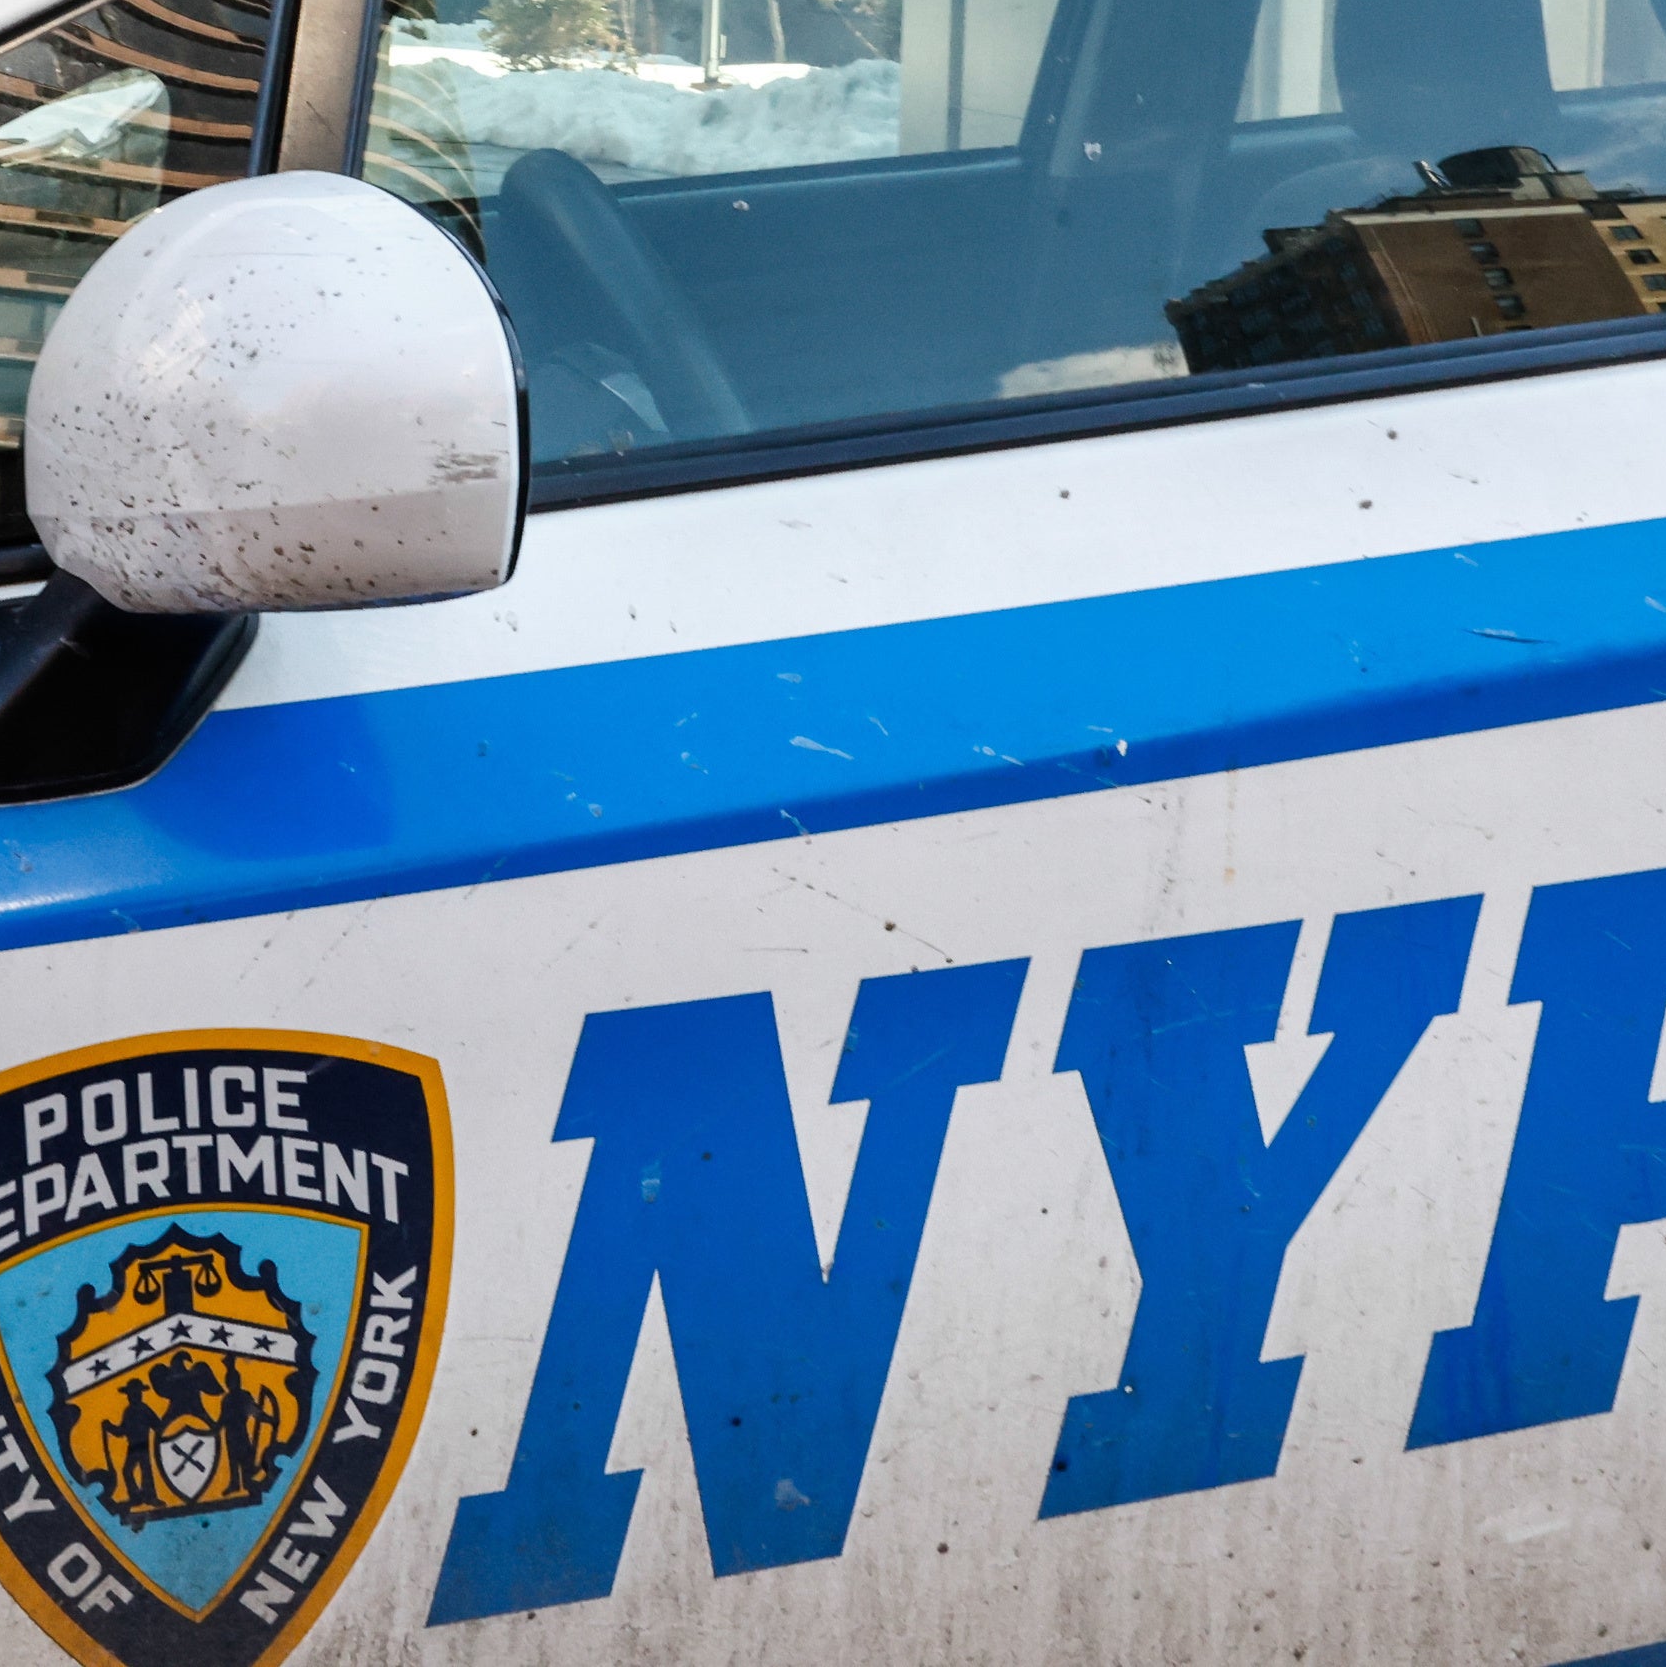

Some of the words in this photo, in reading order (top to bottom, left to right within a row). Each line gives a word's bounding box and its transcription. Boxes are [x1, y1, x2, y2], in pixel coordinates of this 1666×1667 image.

[22, 1065, 310, 1166] POLICE
[46, 1541, 134, 1618] OF
[238, 1475, 348, 1626] NEW
[332, 1264, 419, 1447] YORK
